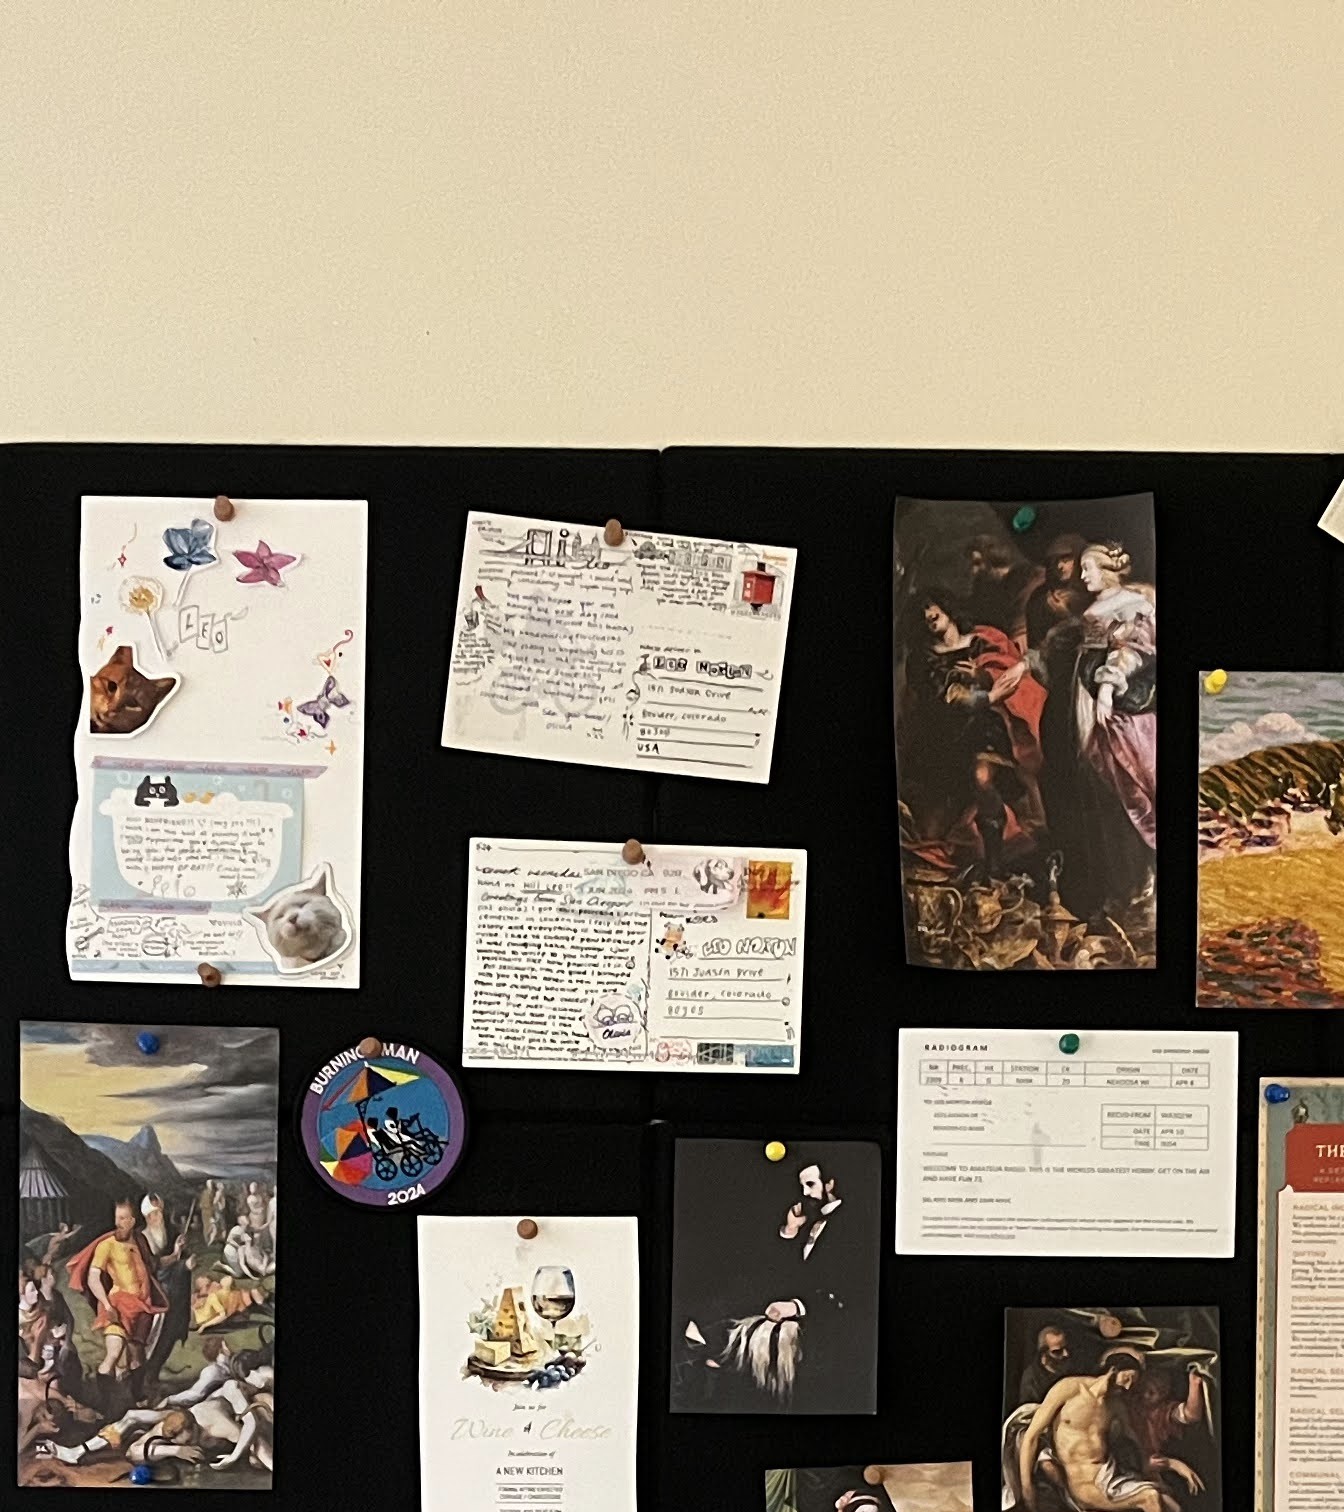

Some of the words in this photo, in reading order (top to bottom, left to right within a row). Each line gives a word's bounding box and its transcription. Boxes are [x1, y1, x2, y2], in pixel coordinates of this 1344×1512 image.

[380, 1043, 420, 1065] MAN
[387, 1184, 426, 1205] 2024
[539, 1418, 613, 1440] Cheese
[504, 1466, 524, 1475] NEW
[526, 1466, 563, 1475] KITCHEN
